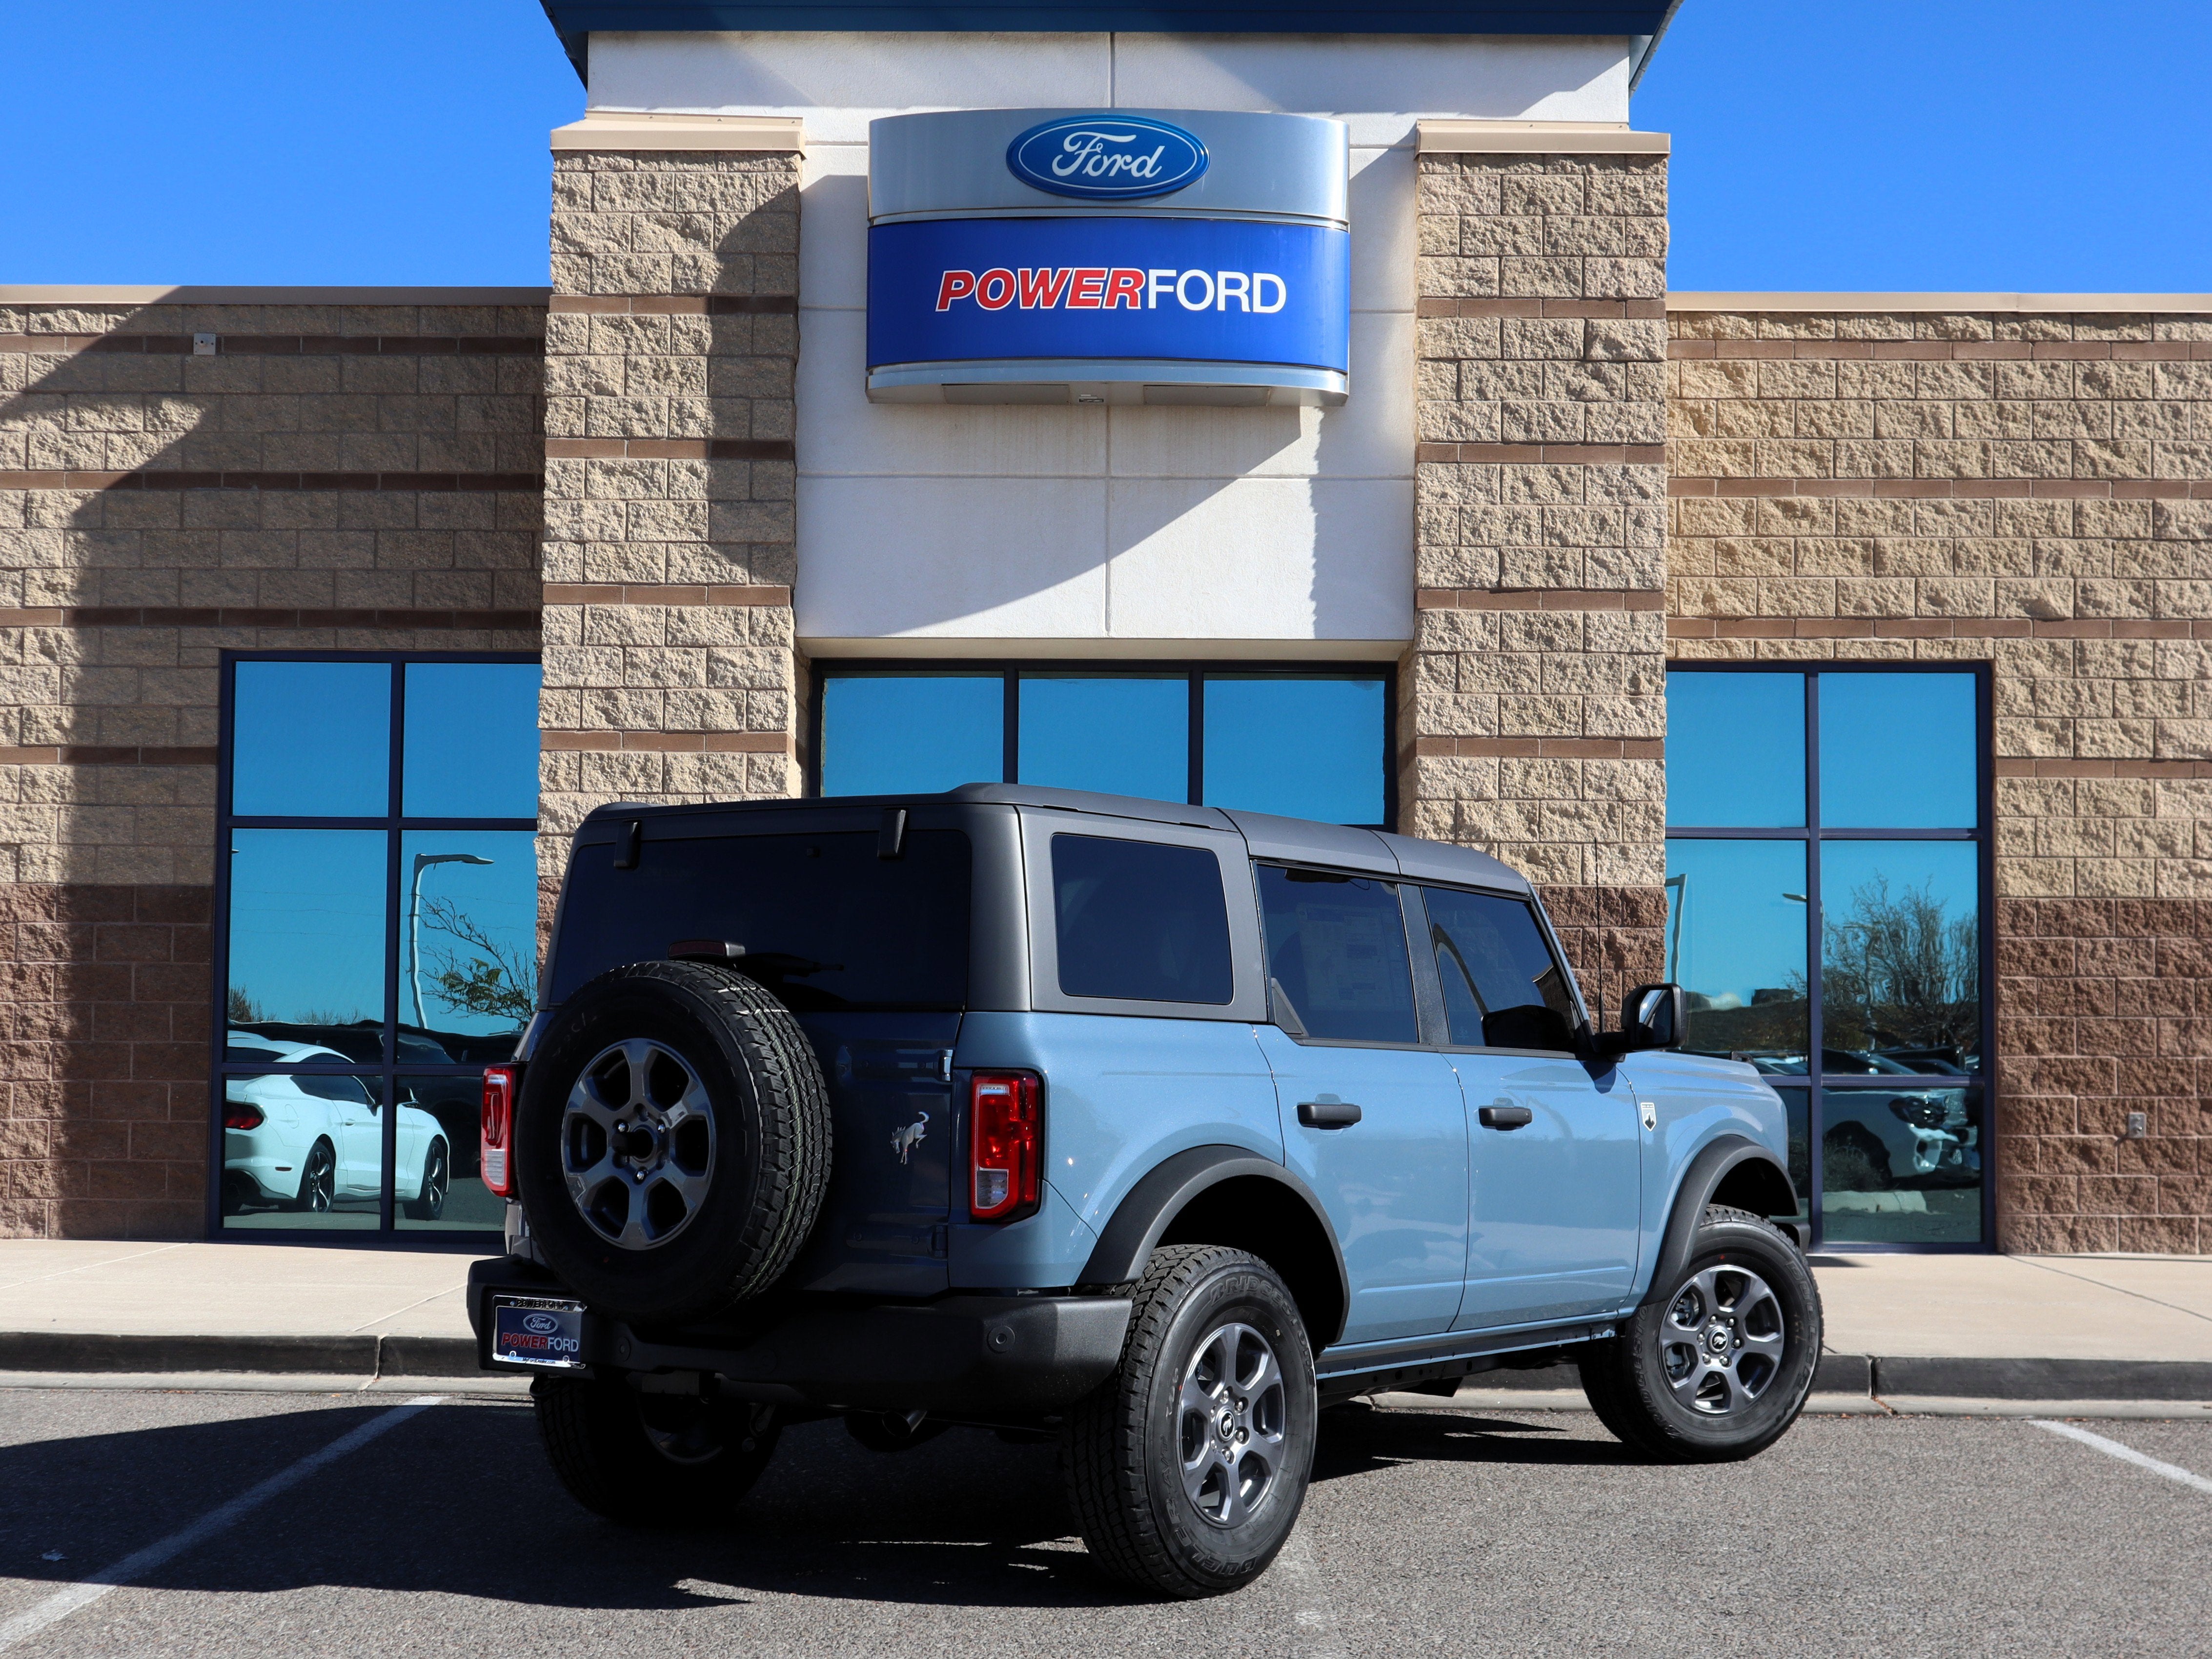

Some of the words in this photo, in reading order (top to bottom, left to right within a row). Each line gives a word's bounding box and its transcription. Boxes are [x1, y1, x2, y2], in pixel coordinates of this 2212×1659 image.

[1052, 132, 1165, 178] Ford
[935, 268, 1286, 313] POWERFORD
[501, 1333, 579, 1352] POWERFORD
[530, 1317, 551, 1330] Ford
[1210, 1275, 1315, 1387] BRIDGESTONE
[1633, 1306, 1683, 1438] BRIDGESTO
[1165, 1498, 1258, 1575] DUELER
